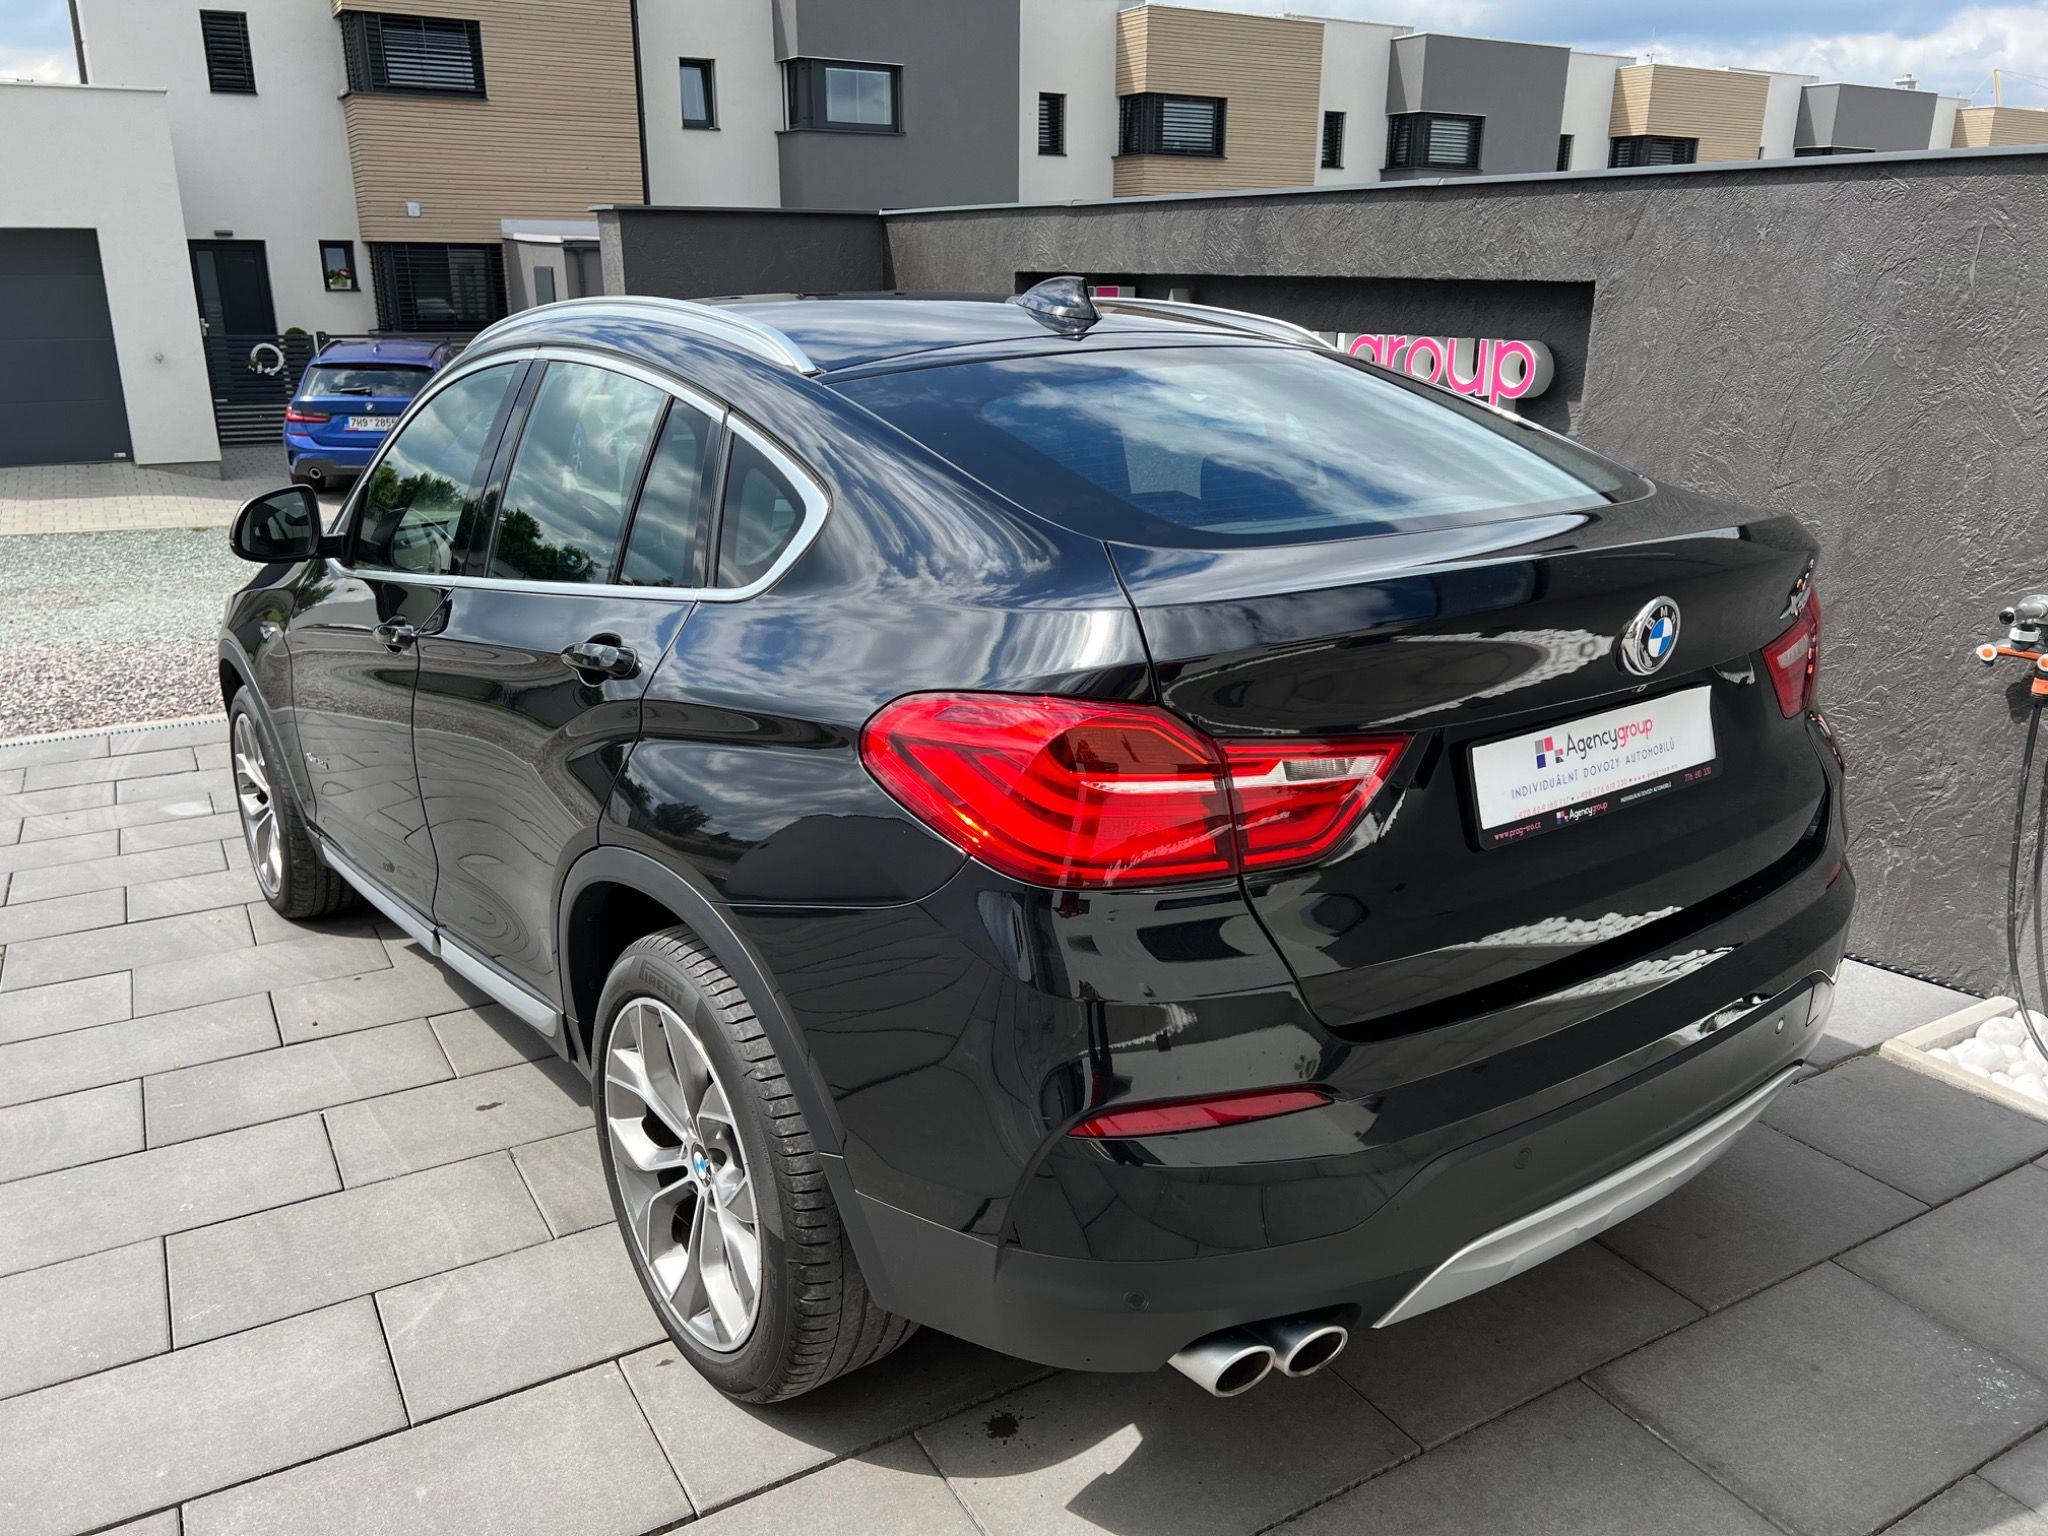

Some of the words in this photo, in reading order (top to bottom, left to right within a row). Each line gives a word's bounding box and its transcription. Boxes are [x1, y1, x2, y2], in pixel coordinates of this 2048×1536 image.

[351, 417, 368, 427] 7H9
[1566, 718, 1654, 760] Agencygroup
[1583, 759, 1619, 778] DOVOZY
